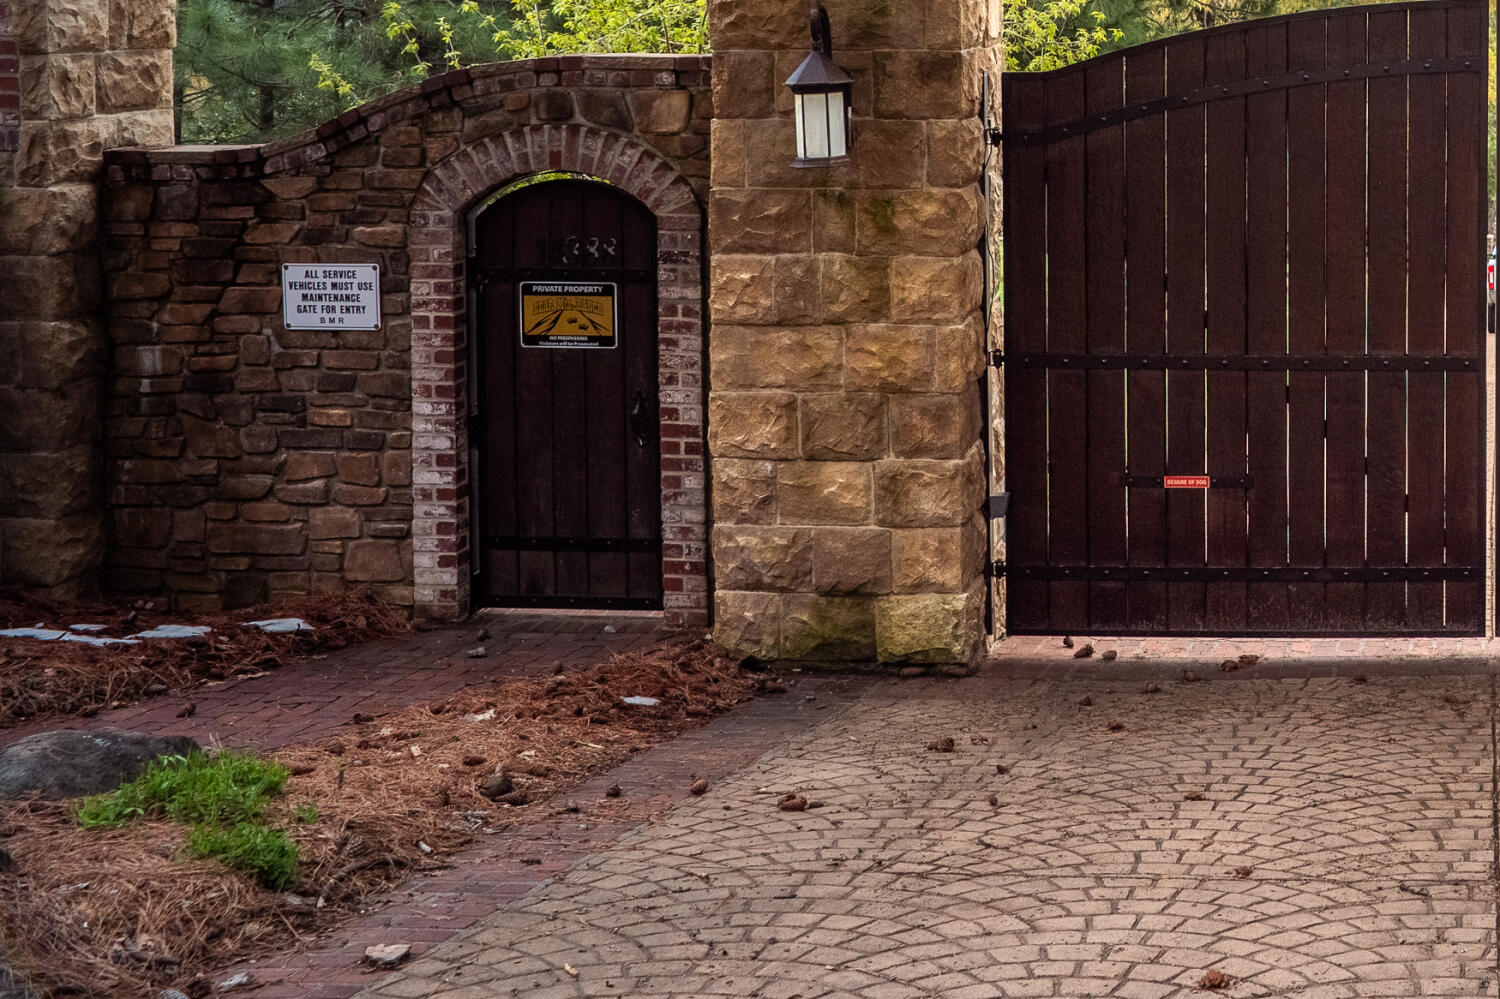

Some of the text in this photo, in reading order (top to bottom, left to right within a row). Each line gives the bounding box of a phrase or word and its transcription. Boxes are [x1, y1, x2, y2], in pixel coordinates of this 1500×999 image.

[304, 270, 357, 279] ALL SERVICE
[288, 281, 374, 291] VEHICLES MUST USE
[564, 285, 603, 293] PROPERTY
[301, 293, 361, 302] MAINTENANCE
[296, 304, 367, 314] GATE FOR ENTRY
